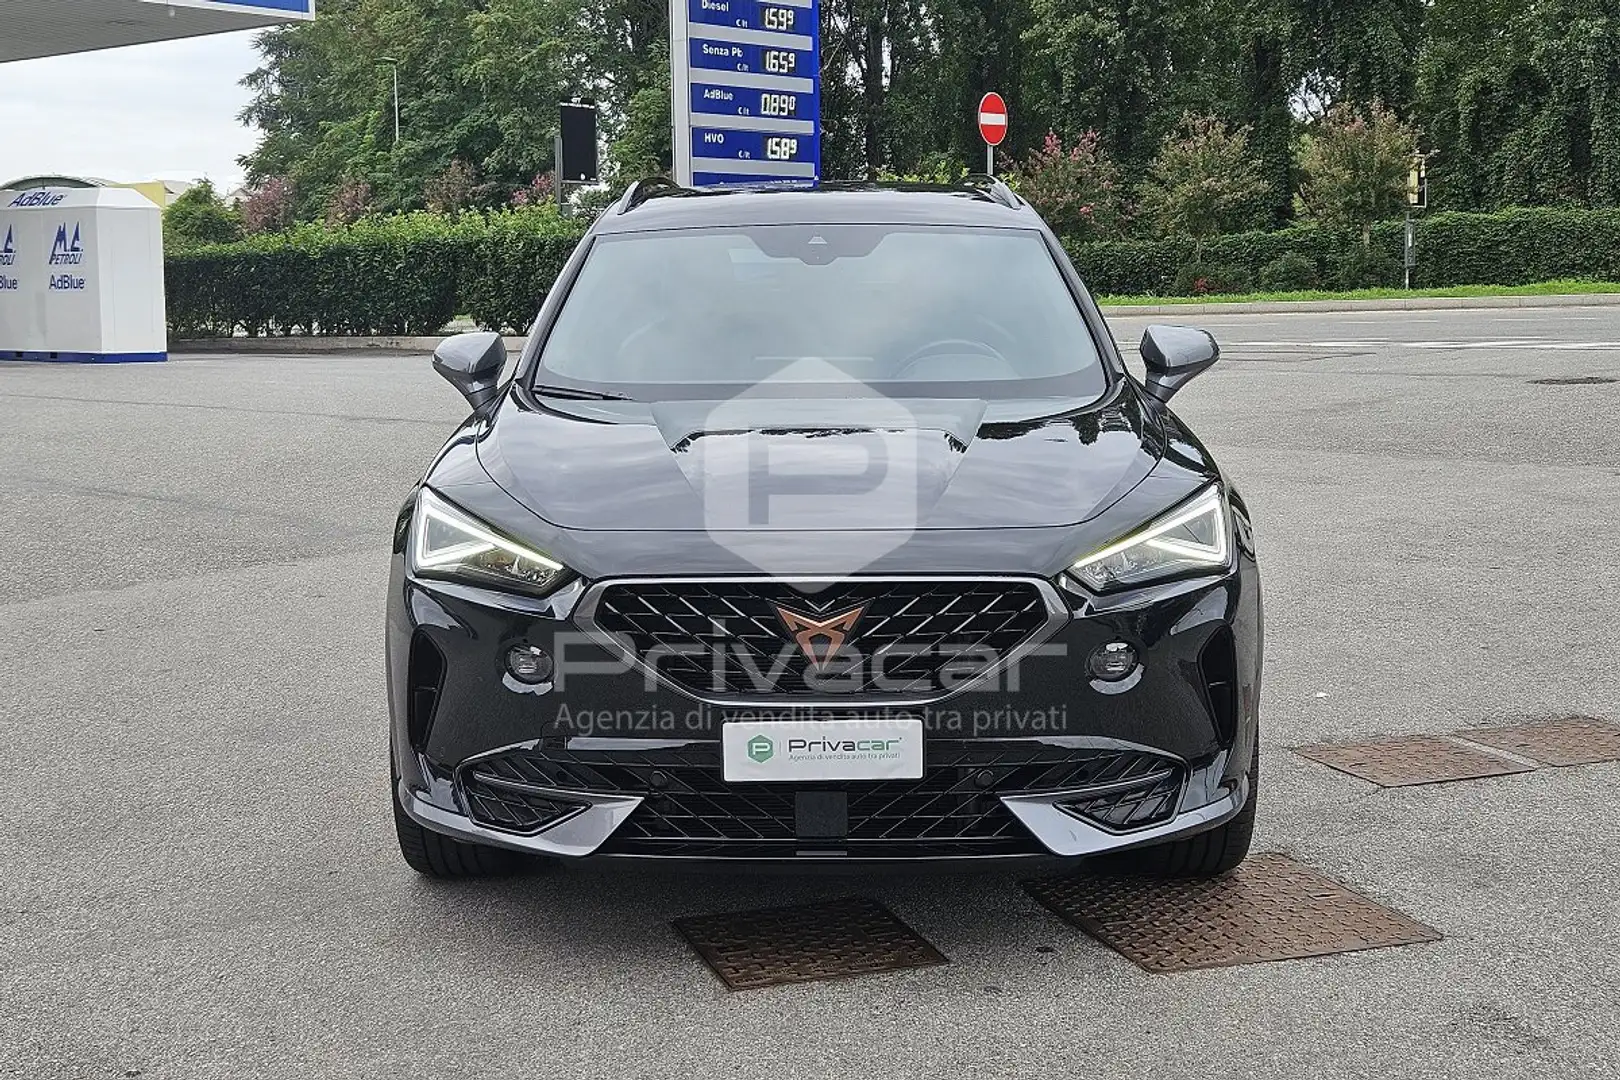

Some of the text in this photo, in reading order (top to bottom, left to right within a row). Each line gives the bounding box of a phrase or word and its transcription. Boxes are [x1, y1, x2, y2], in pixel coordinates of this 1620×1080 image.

[701, 0, 729, 12] Diesel
[702, 44, 743, 58] Senza Pb
[703, 88, 734, 101] AdBlue
[704, 132, 724, 144] HVO
[7, 191, 64, 207] AdBlue
[49, 253, 82, 264] PETROLI
[49, 274, 85, 289] AdBlue
[788, 736, 901, 752] Privacar
